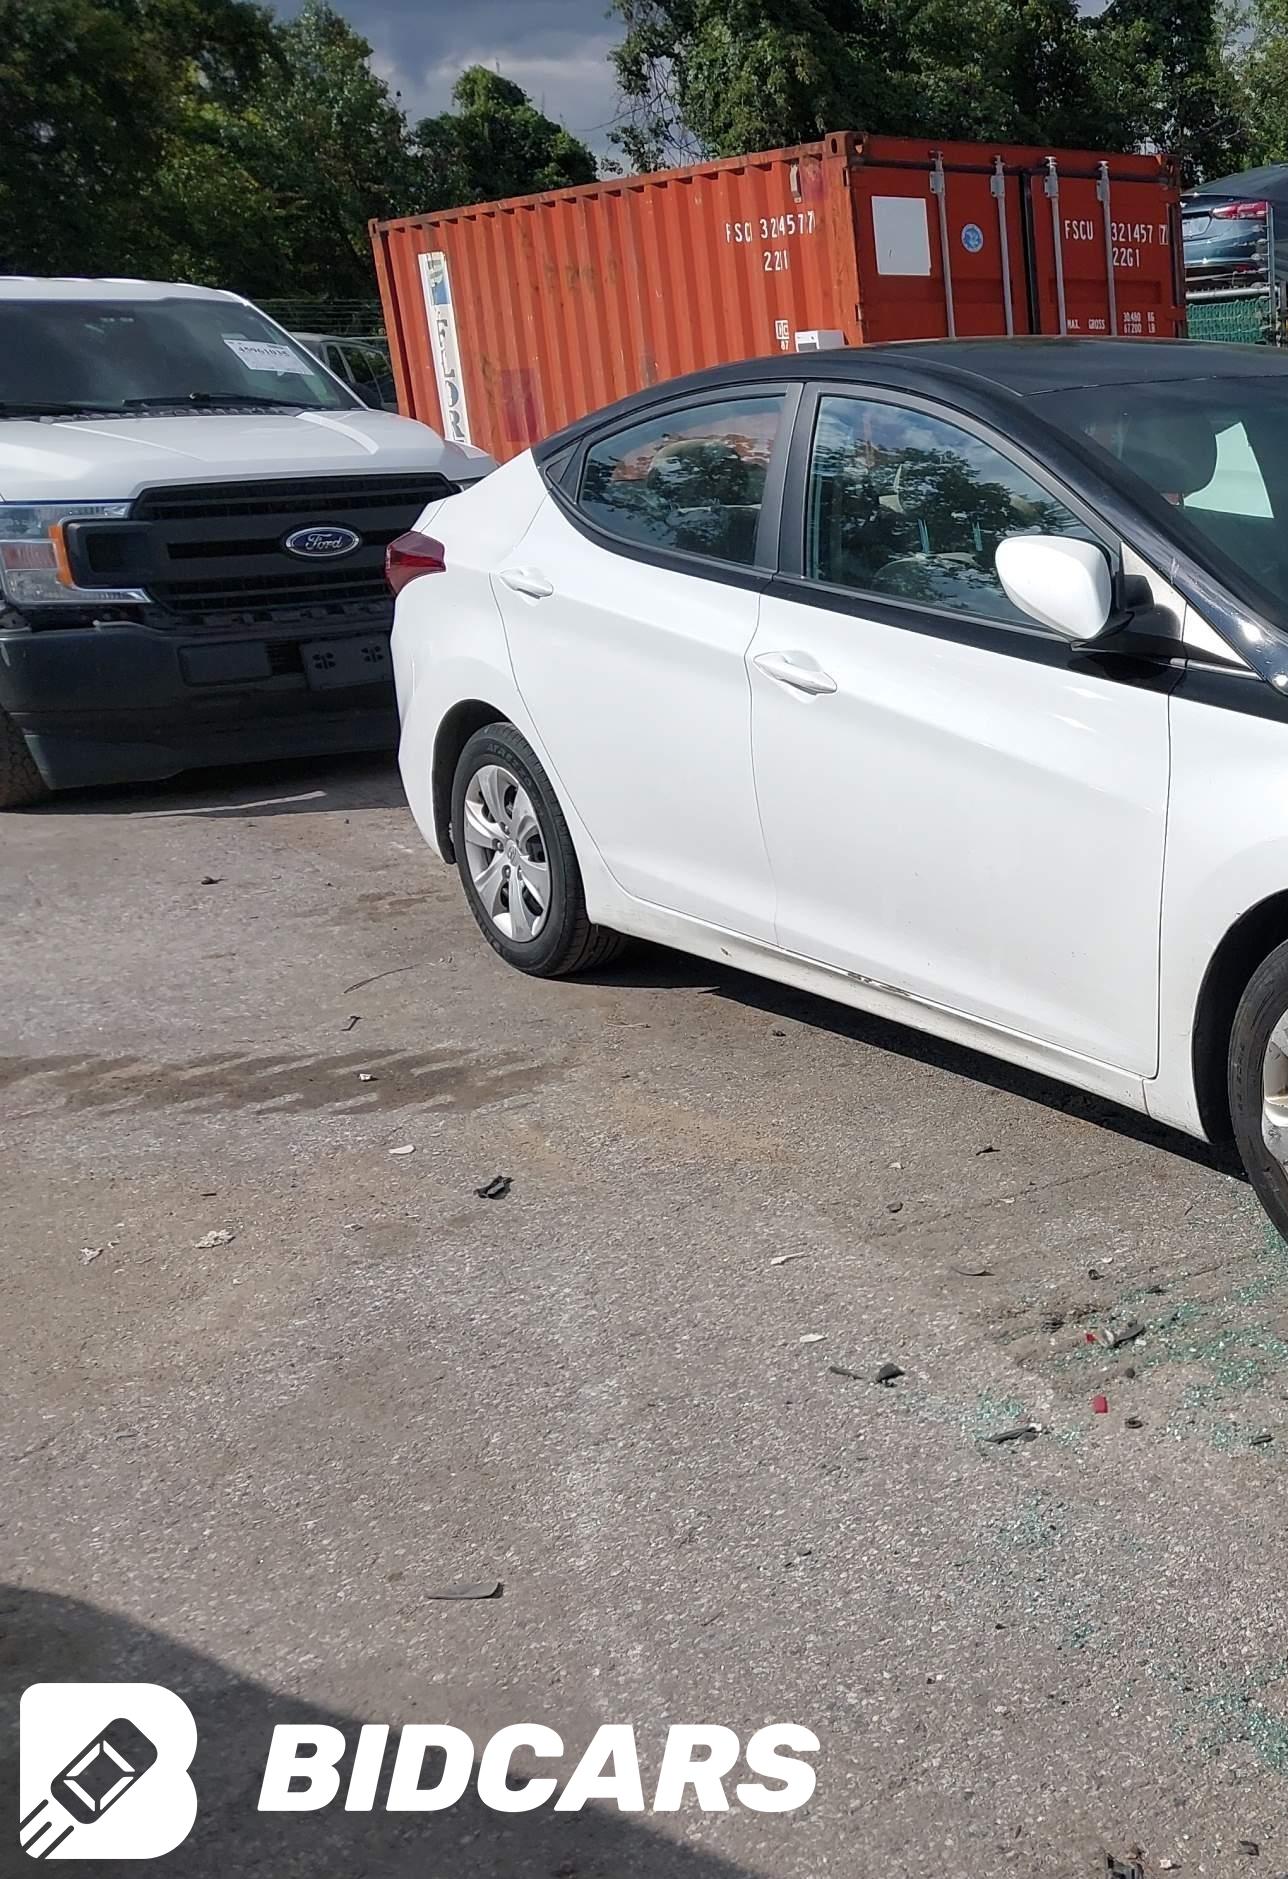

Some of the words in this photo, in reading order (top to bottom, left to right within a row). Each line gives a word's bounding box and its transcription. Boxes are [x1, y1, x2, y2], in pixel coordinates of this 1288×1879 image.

[1064, 220, 1094, 241] FSCU
[1111, 222, 1153, 244] 321457
[1159, 223, 1168, 245] 7
[1112, 247, 1140, 268] 22G1
[305, 533, 343, 550] Ford
